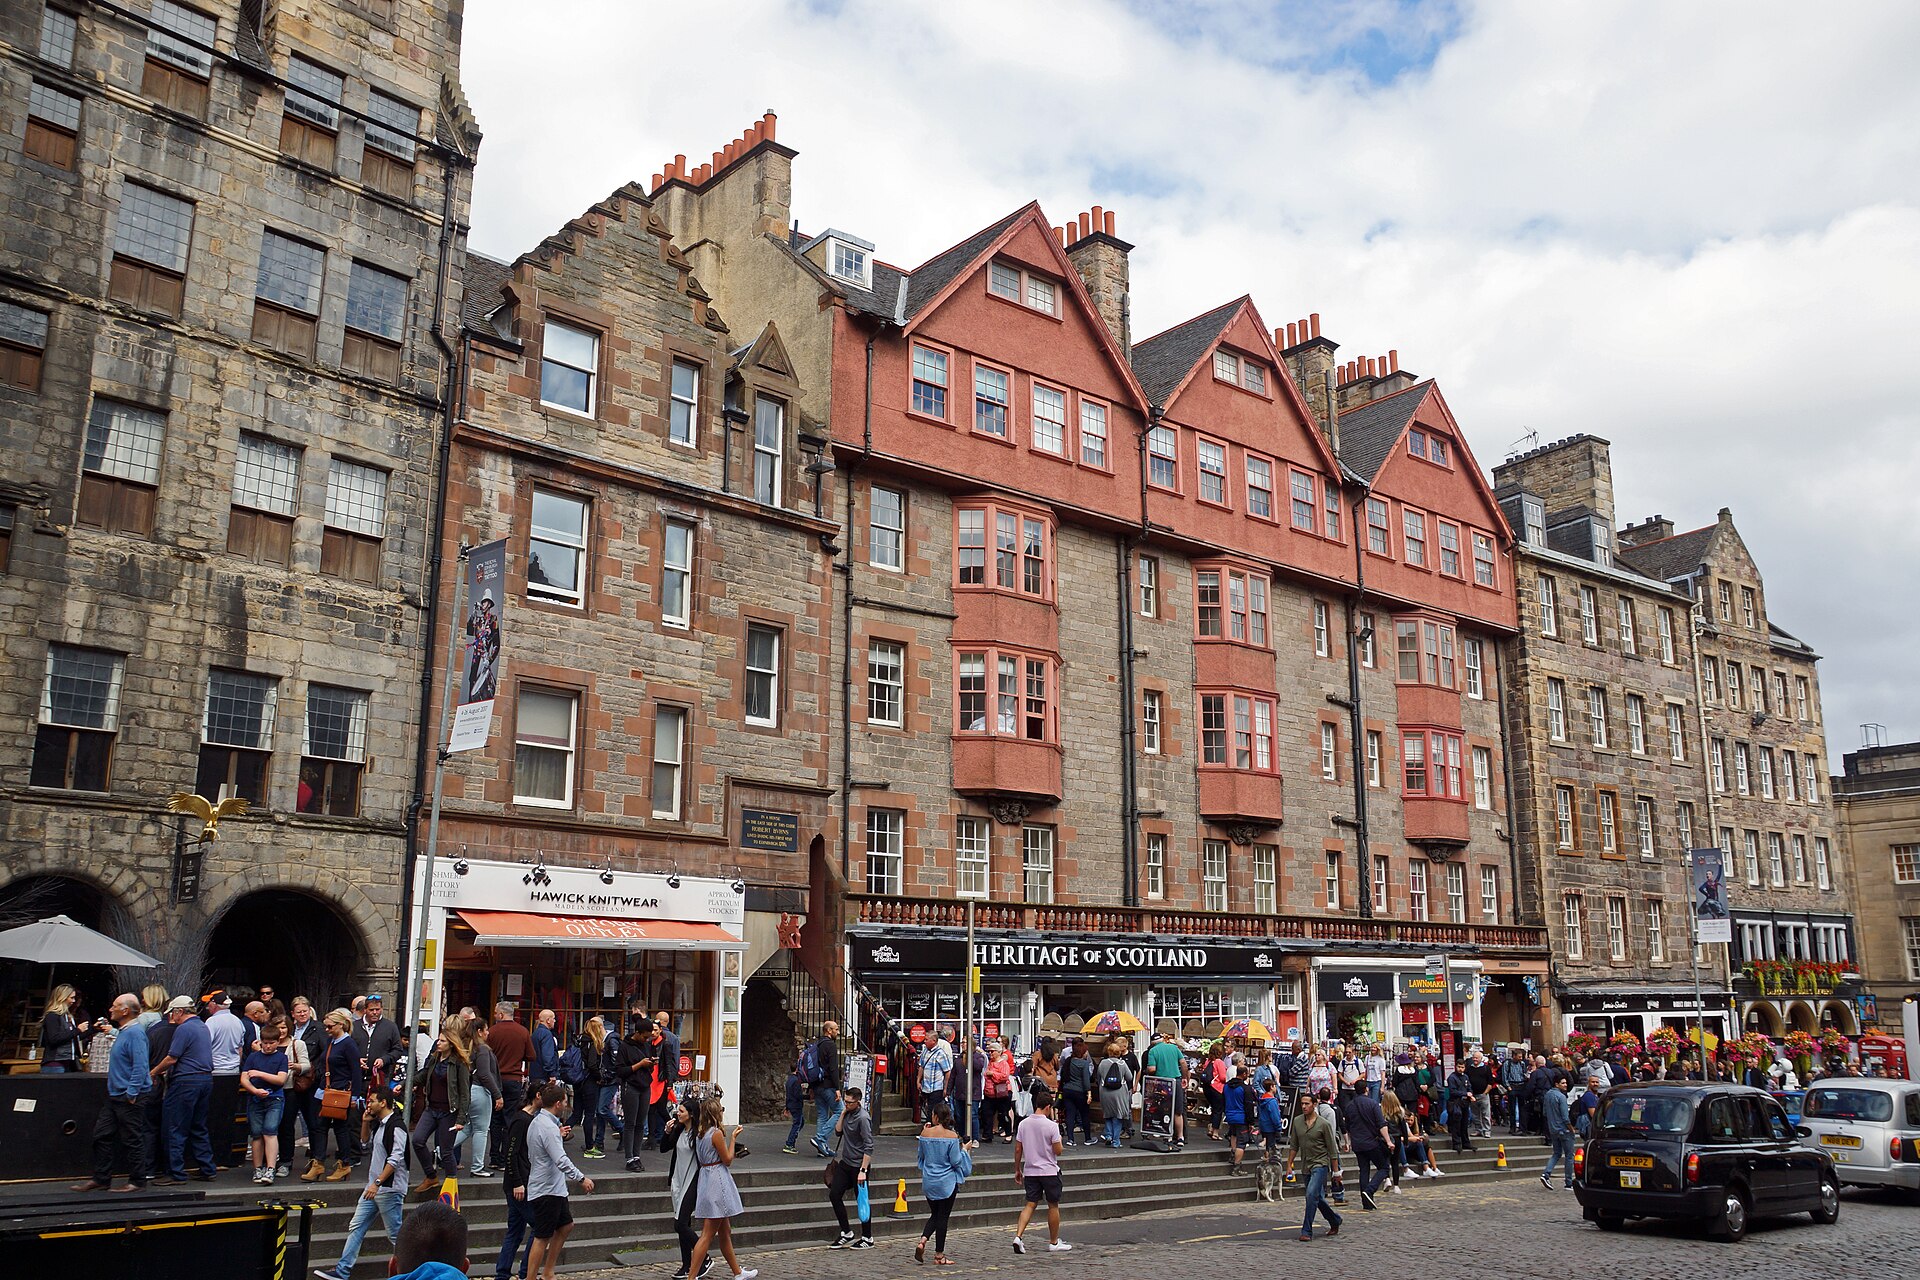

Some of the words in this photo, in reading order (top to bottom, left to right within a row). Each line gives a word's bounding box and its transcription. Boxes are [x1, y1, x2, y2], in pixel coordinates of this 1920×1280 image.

[530, 890, 585, 904] HAWICK
[587, 894, 660, 908] KNITWEAR
[707, 899, 740, 907] PLATINUM
[586, 904, 626, 913] SCOTLAND
[708, 907, 738, 915] STOCKIST
[565, 923, 647, 938] OUTLET
[972, 944, 1079, 966] HERITAGE
[1106, 947, 1207, 967] SCOTLAND
[1615, 1157, 1632, 1165] SN51
[1633, 1158, 1648, 1166] WPZ
